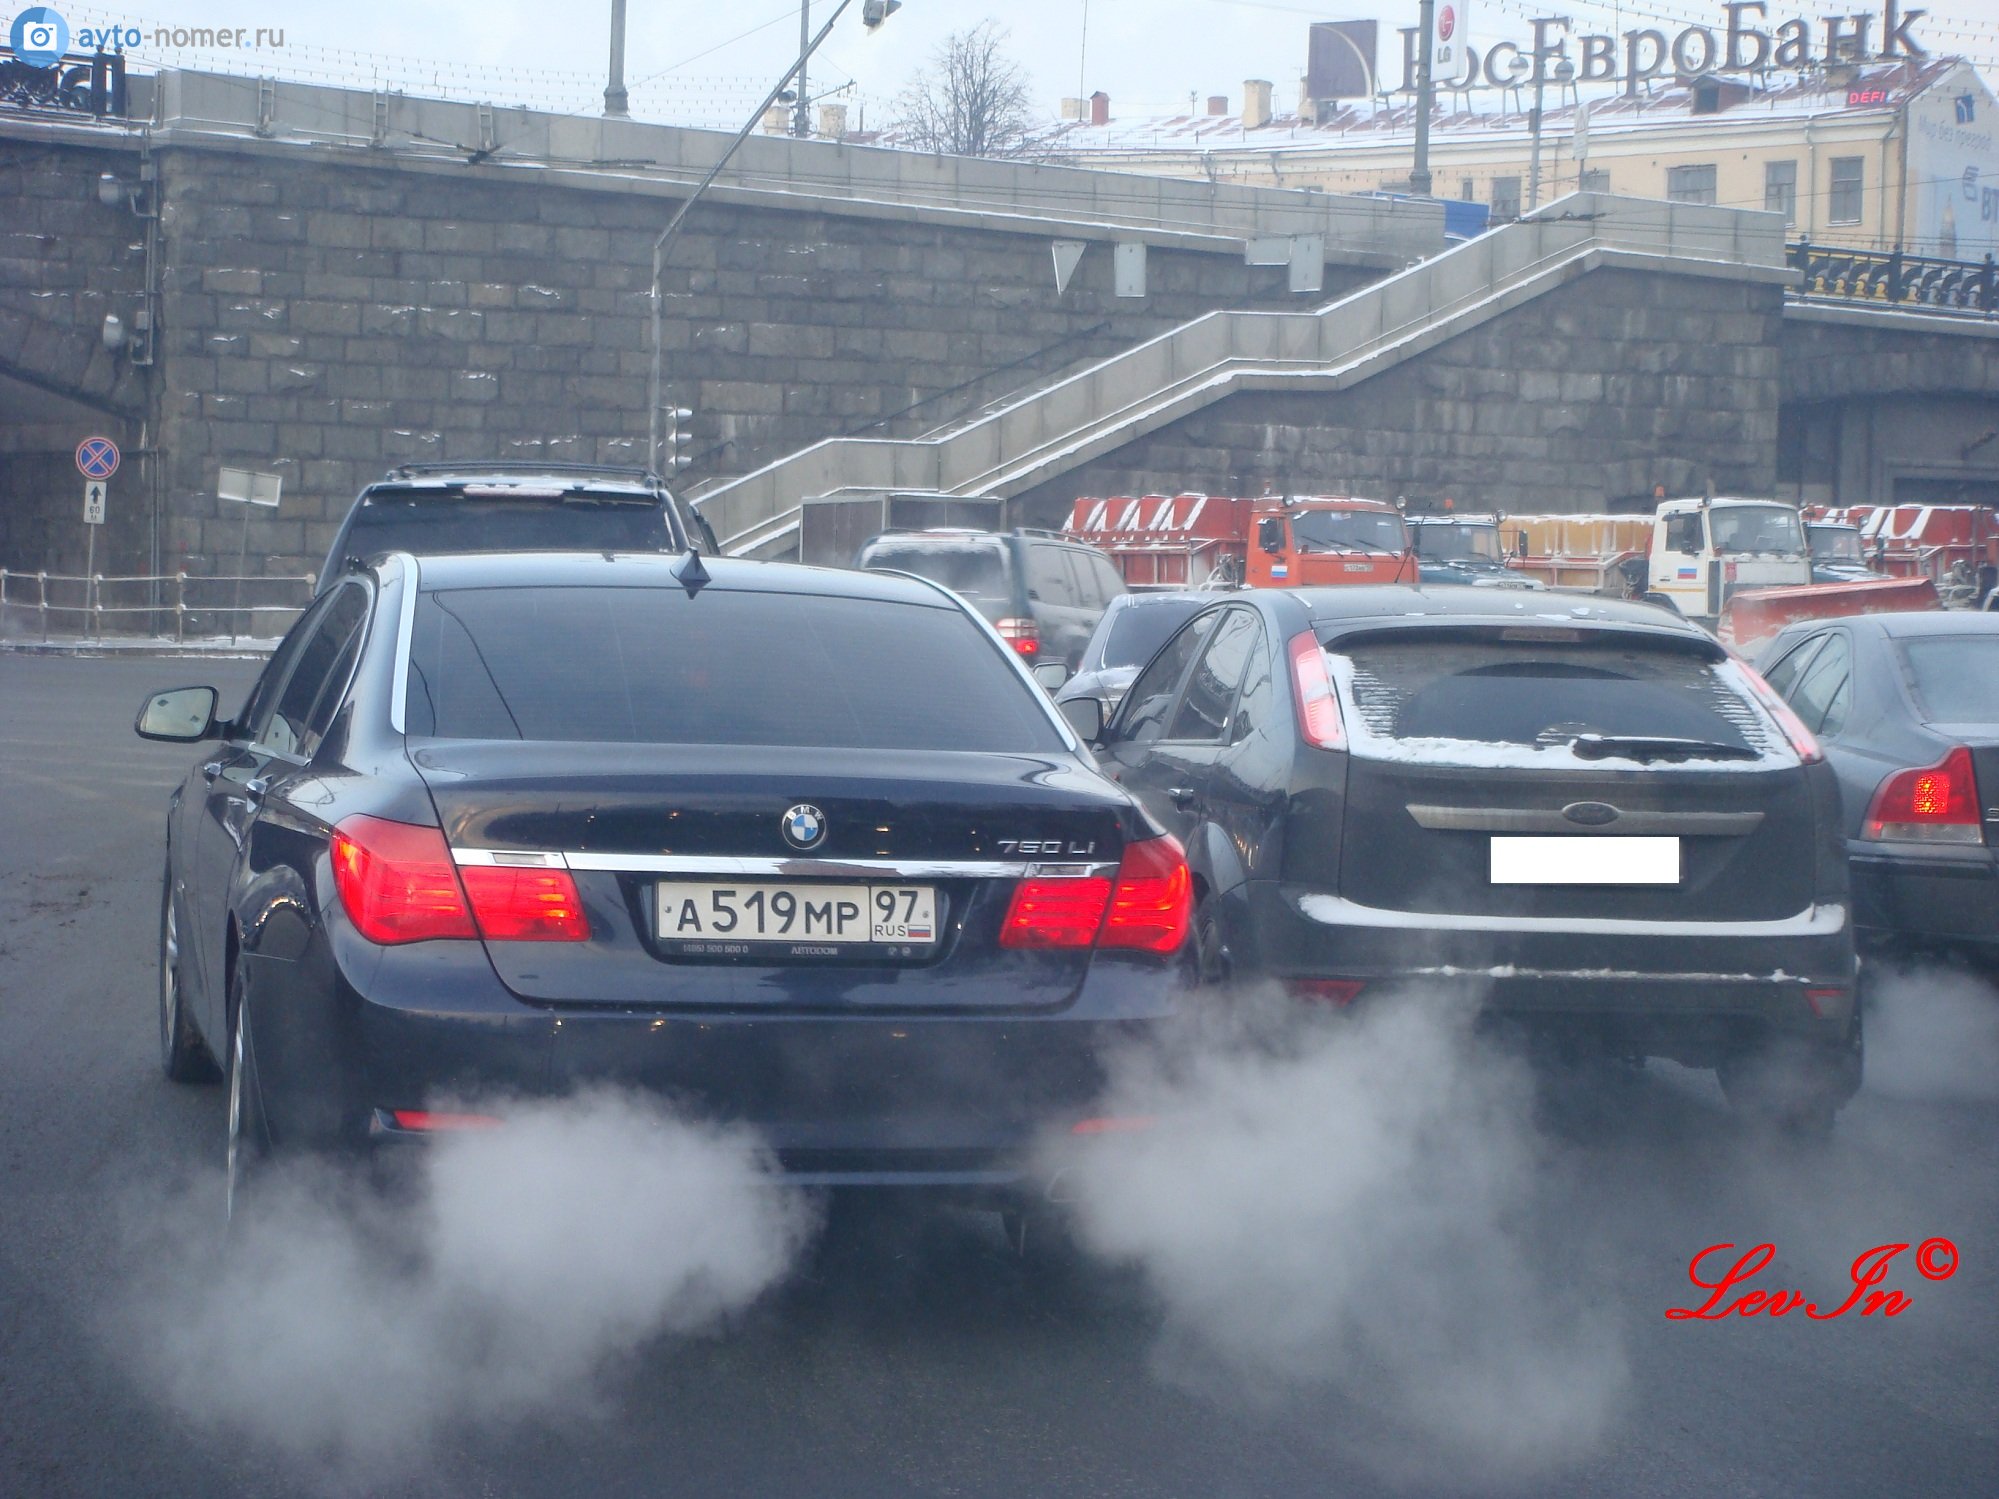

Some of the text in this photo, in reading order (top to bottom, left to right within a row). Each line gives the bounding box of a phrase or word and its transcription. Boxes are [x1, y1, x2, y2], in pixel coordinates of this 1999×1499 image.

[1437, 46, 1452, 64] LG
[1849, 91, 1886, 104] DEFI
[89, 505, 101, 514] 60
[786, 805, 824, 821] BMW
[997, 840, 1062, 854] 750
[875, 889, 919, 924] 97
[874, 924, 907, 938] RUS
